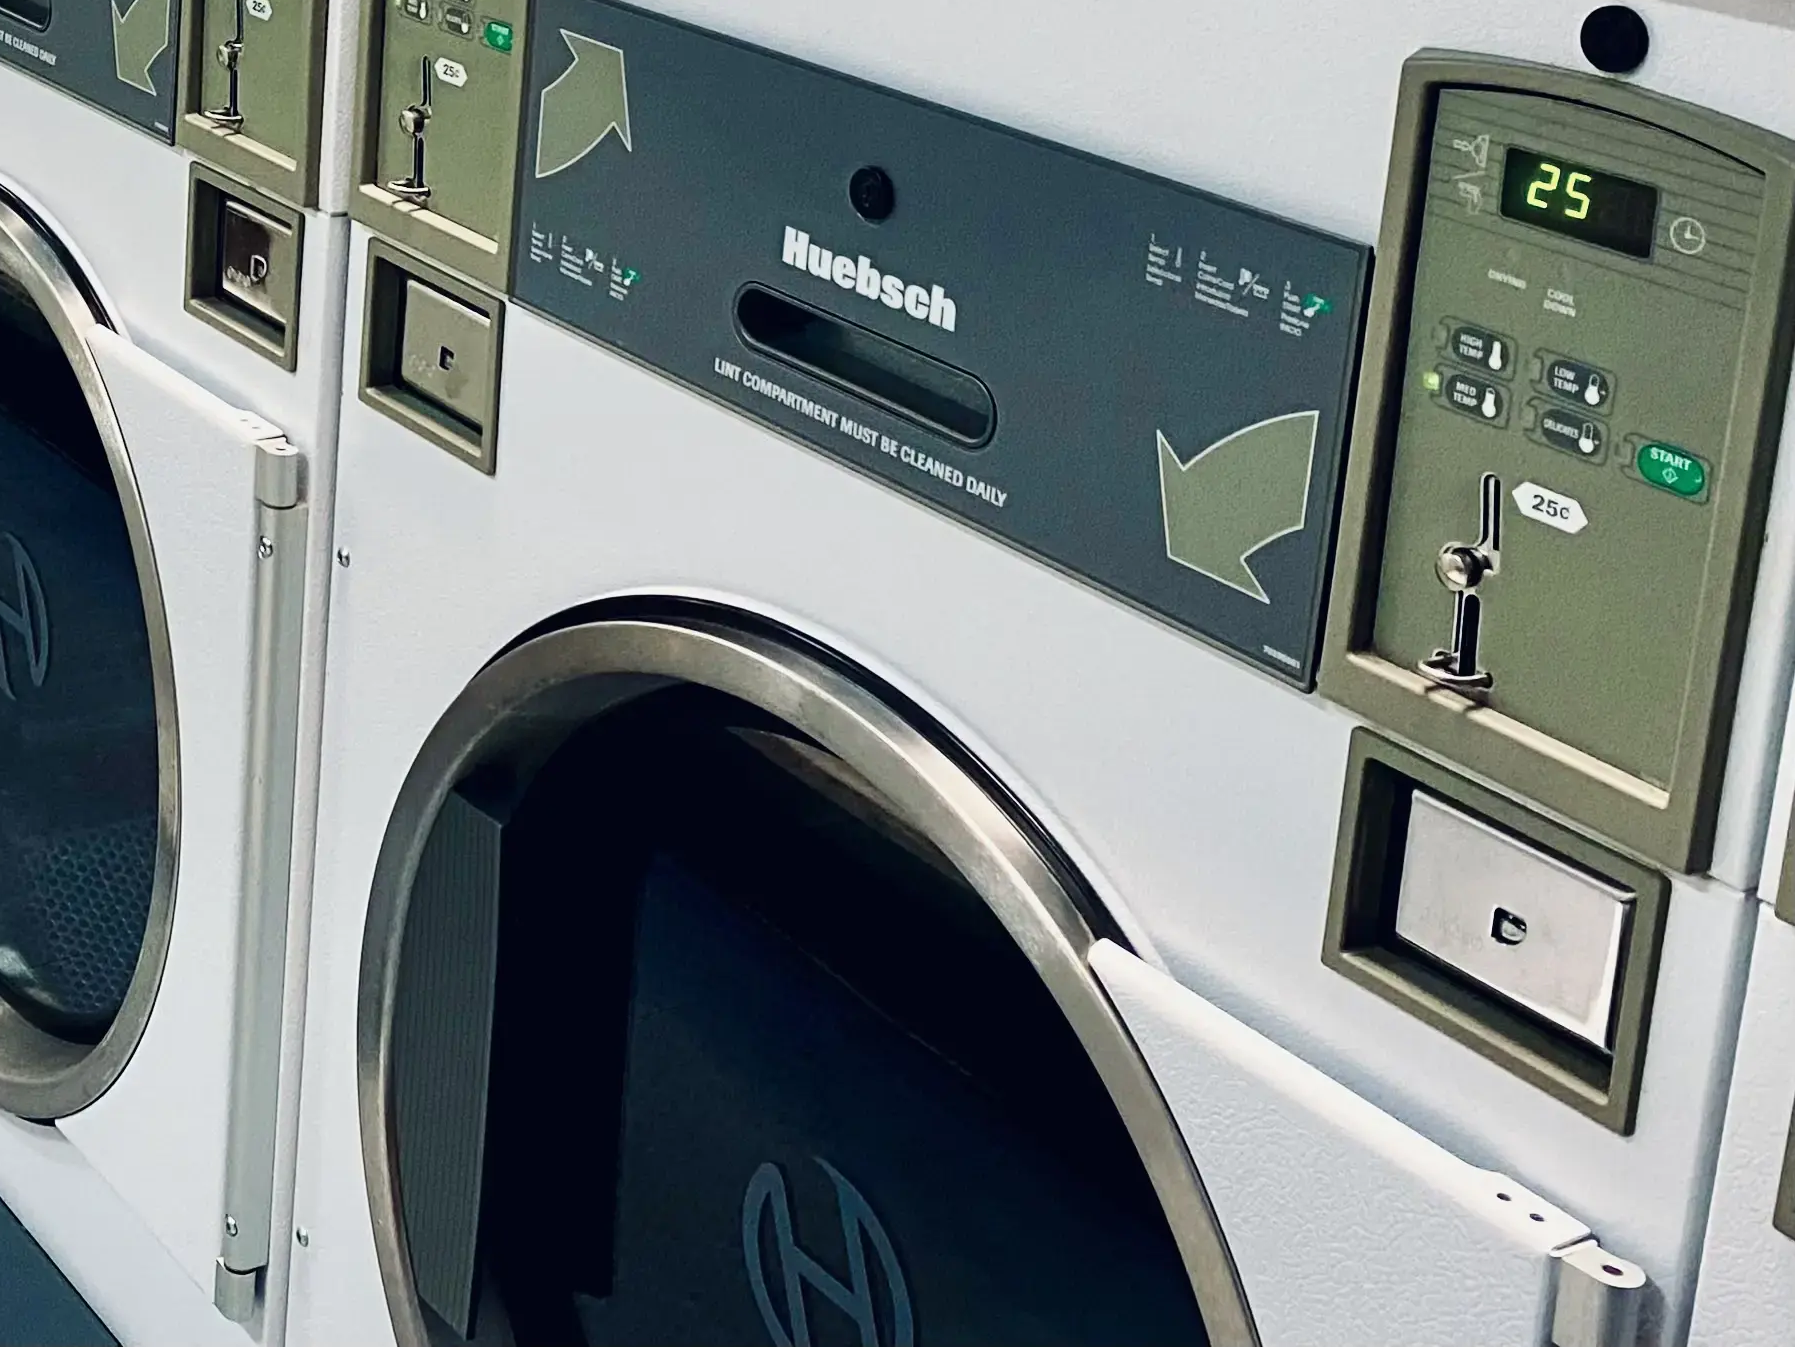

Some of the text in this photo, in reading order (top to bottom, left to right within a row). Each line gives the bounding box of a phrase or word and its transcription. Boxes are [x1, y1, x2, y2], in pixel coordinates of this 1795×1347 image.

[1526, 163, 1592, 220] 25
[781, 225, 957, 332] Huebsch
[1547, 288, 1575, 307] COOL
[1543, 299, 1576, 317] DOWN
[1460, 333, 1483, 349] HIGH
[1459, 343, 1483, 360] TEMP
[1554, 365, 1576, 381] LOW
[1456, 381, 1477, 396] MED
[1554, 377, 1579, 394] TEMP
[1453, 392, 1478, 407] TEMP
[714, 357, 1008, 508] LINT COMPARTMENT MUST BE CLEANED DAILY
[1650, 447, 1692, 471] START
